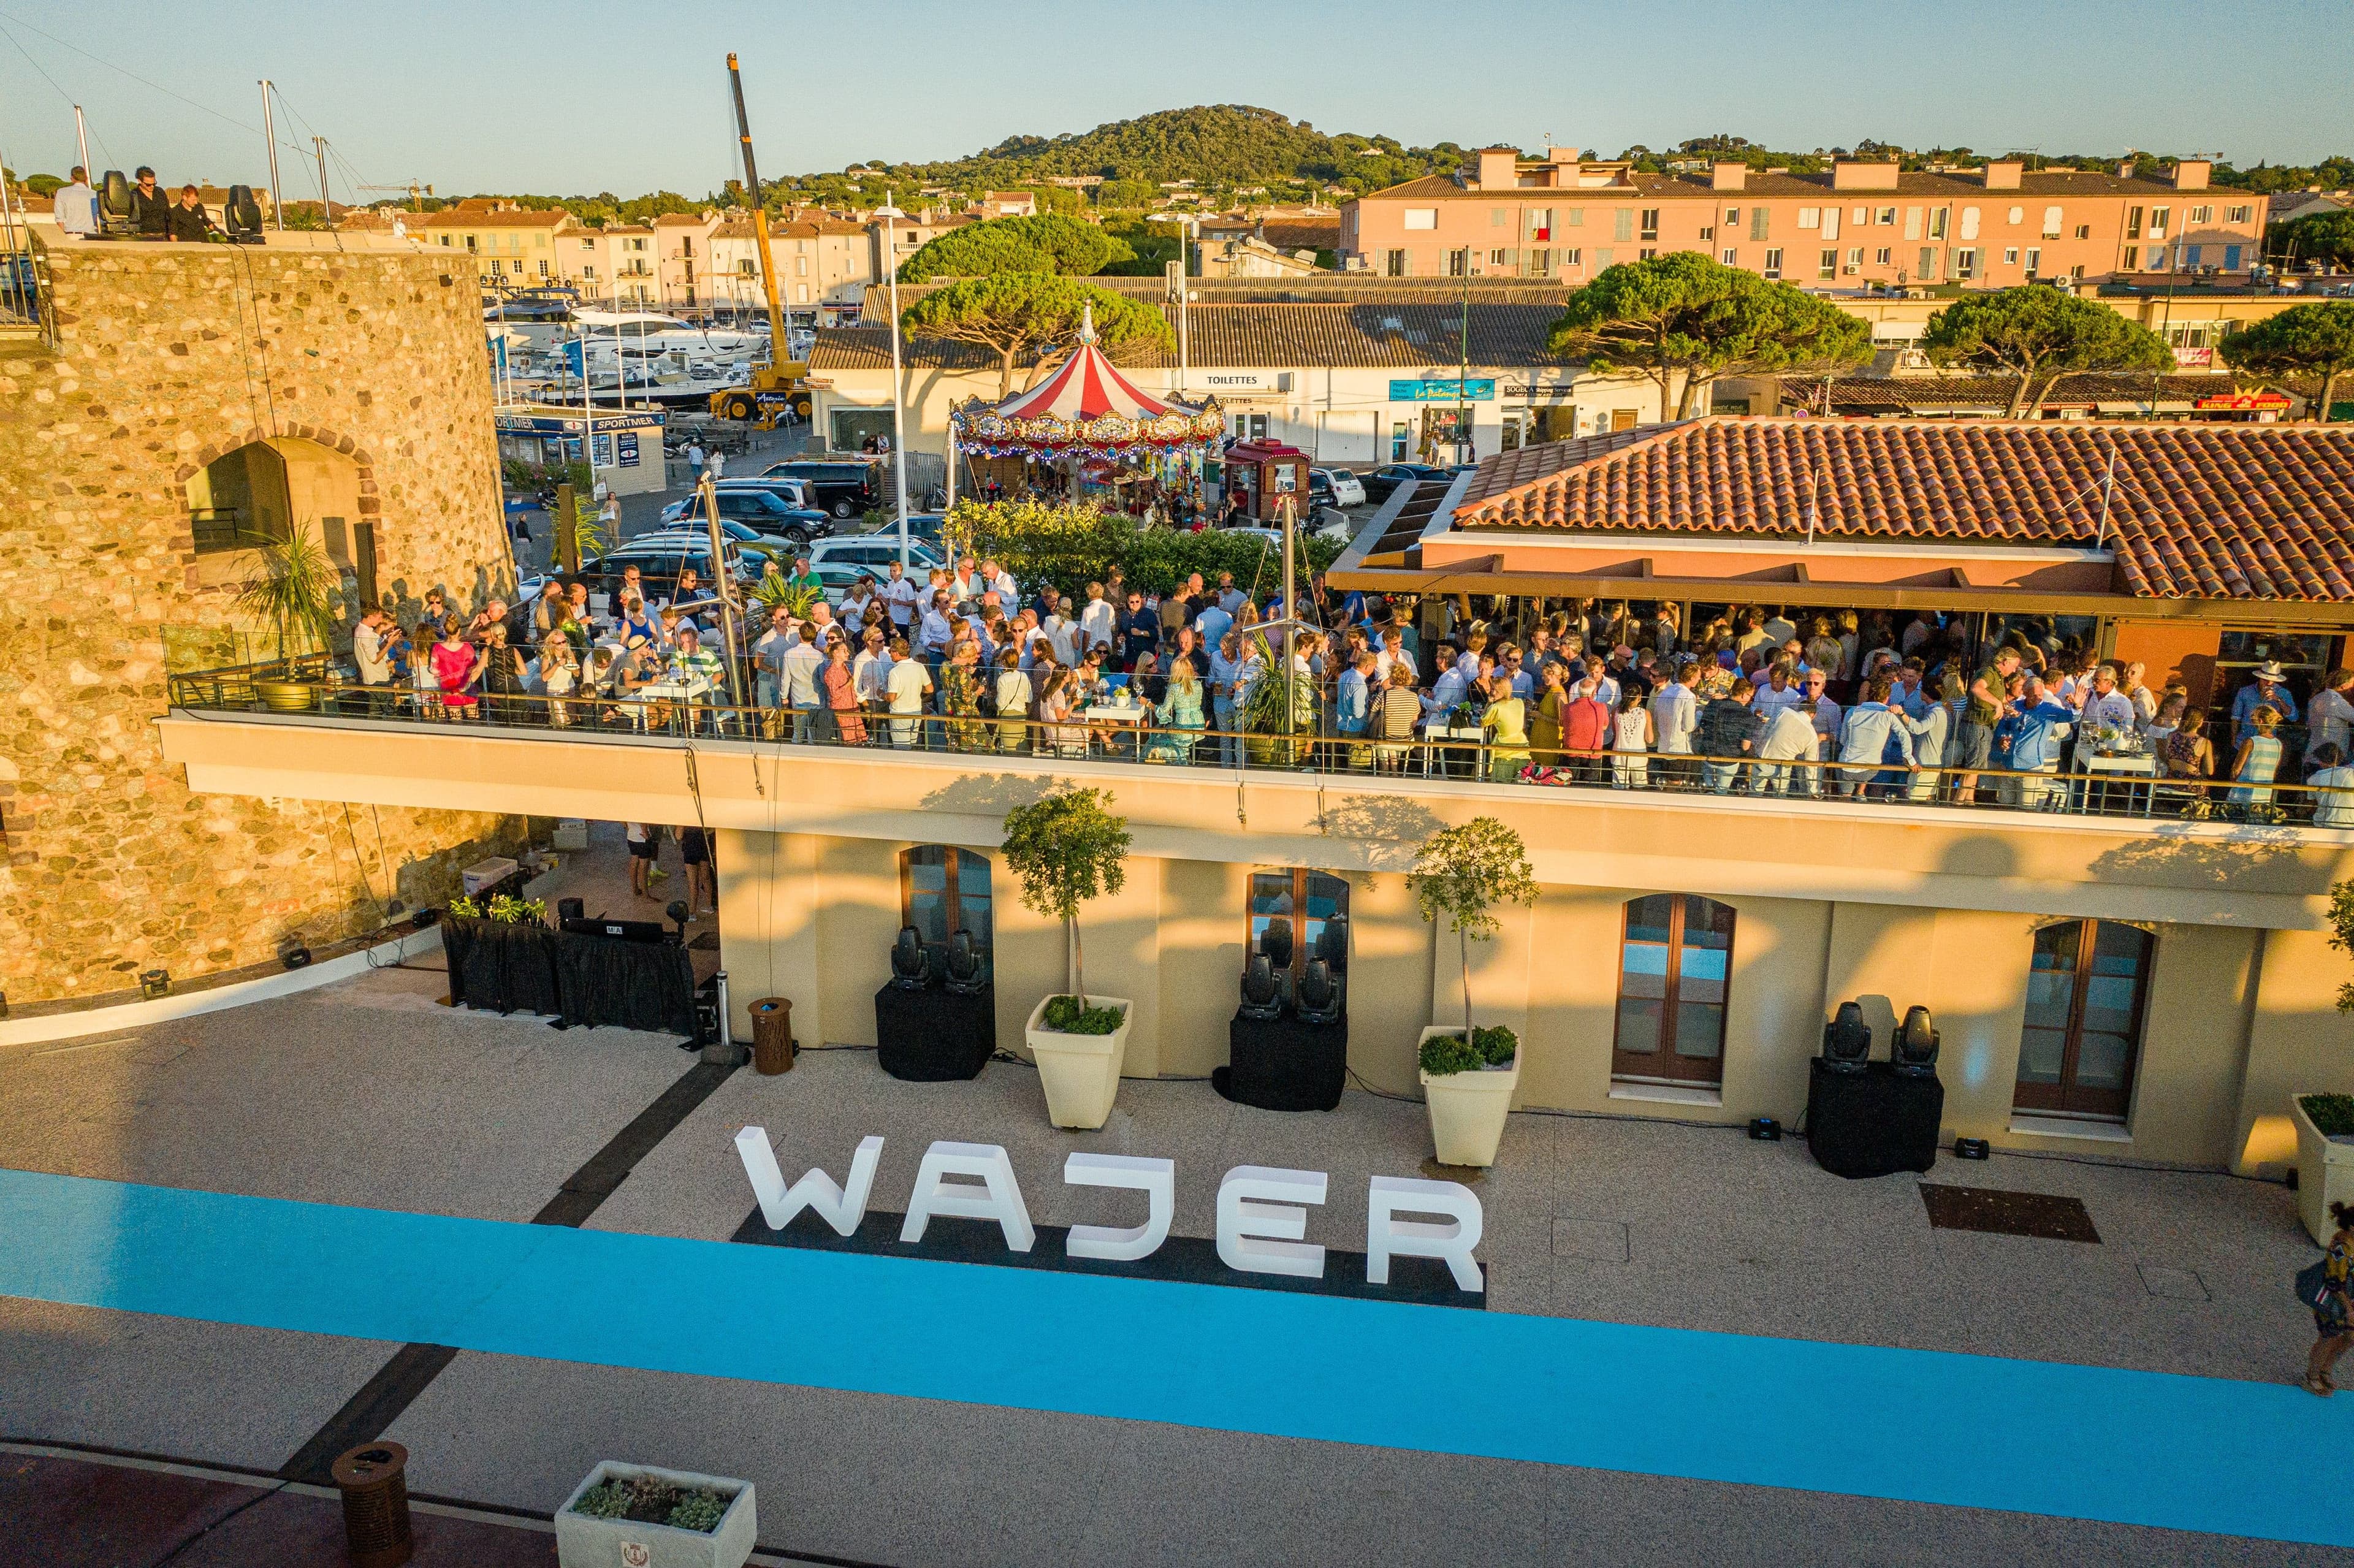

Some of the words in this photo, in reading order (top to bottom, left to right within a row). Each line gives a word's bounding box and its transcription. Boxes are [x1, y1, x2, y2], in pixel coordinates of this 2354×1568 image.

[495, 417, 535, 429] ORTMER
[597, 417, 655, 429] SPORTMER
[735, 1125, 1484, 1292] WAJER
